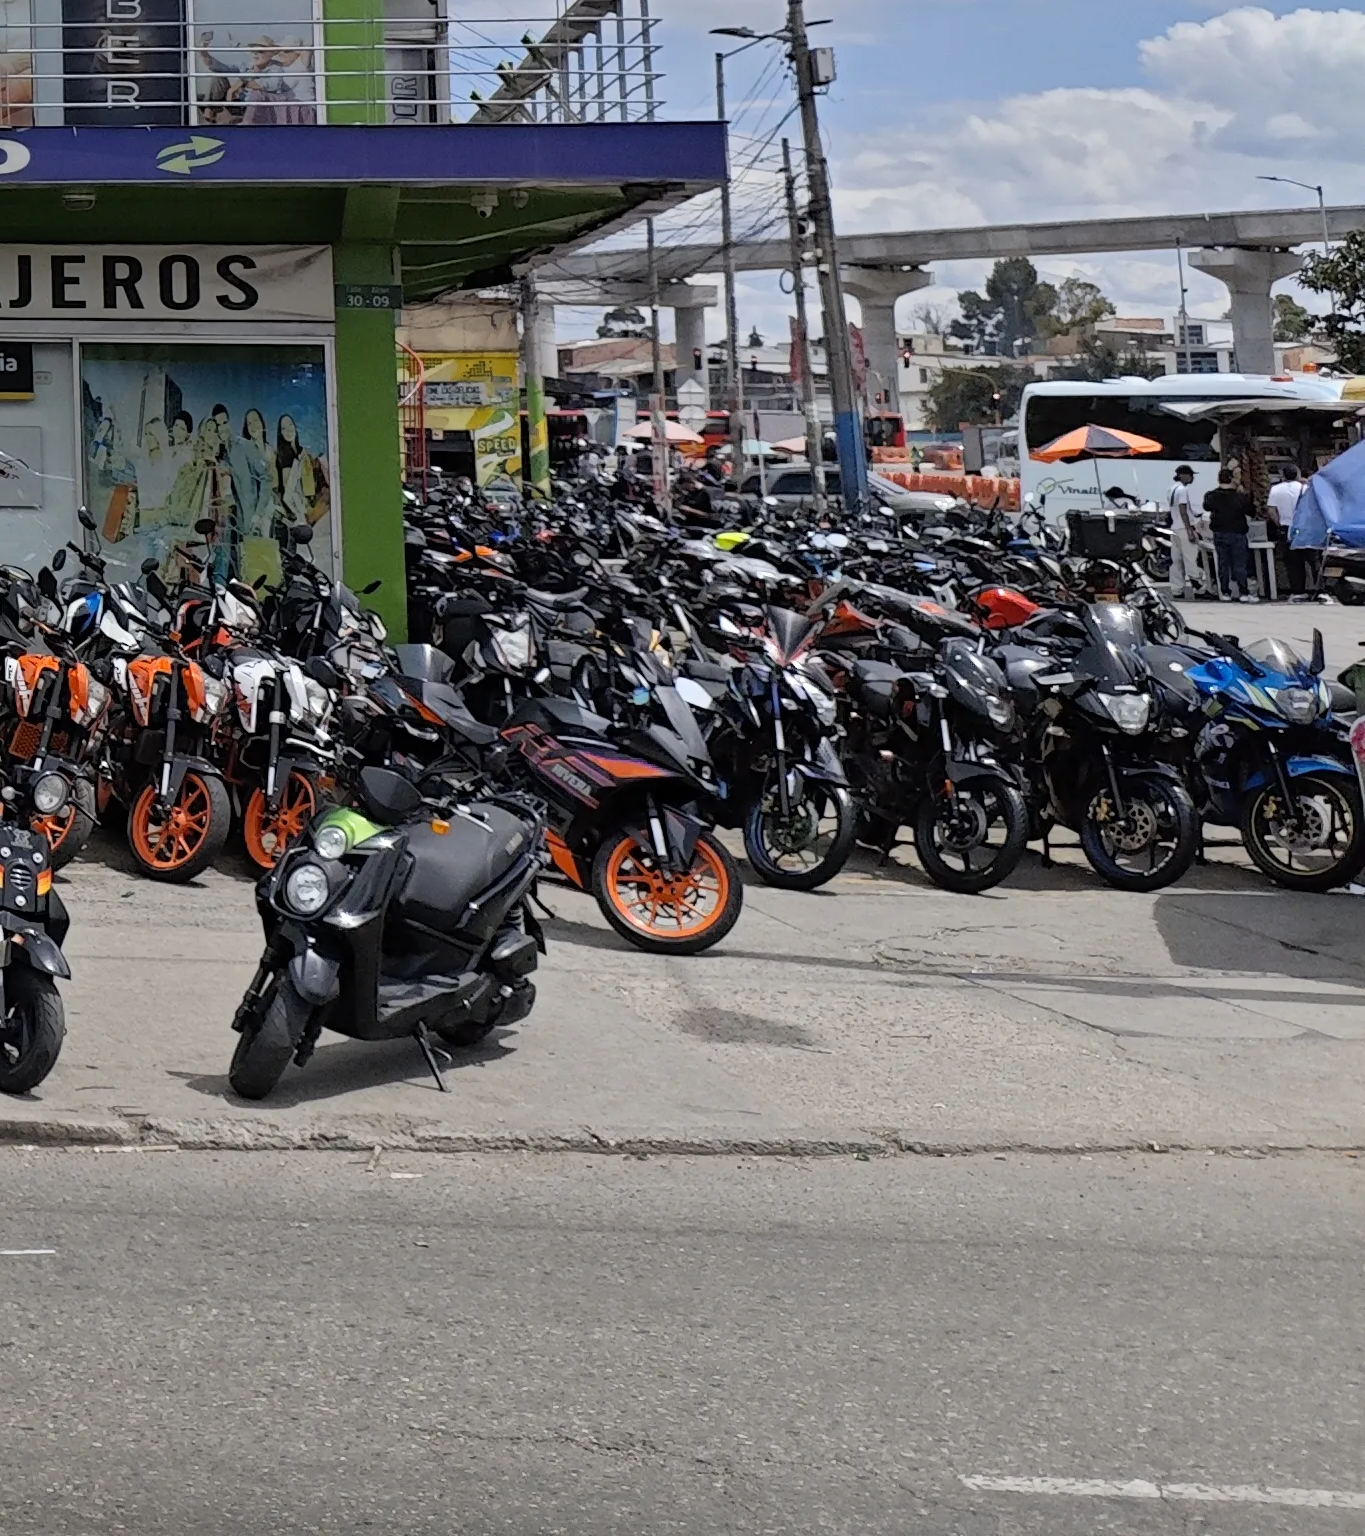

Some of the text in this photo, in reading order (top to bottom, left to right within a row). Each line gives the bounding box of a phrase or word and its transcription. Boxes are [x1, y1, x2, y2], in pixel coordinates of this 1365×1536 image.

[347, 295, 363, 307] 30
[372, 295, 390, 307] 09
[477, 437, 517, 454] SPEED
